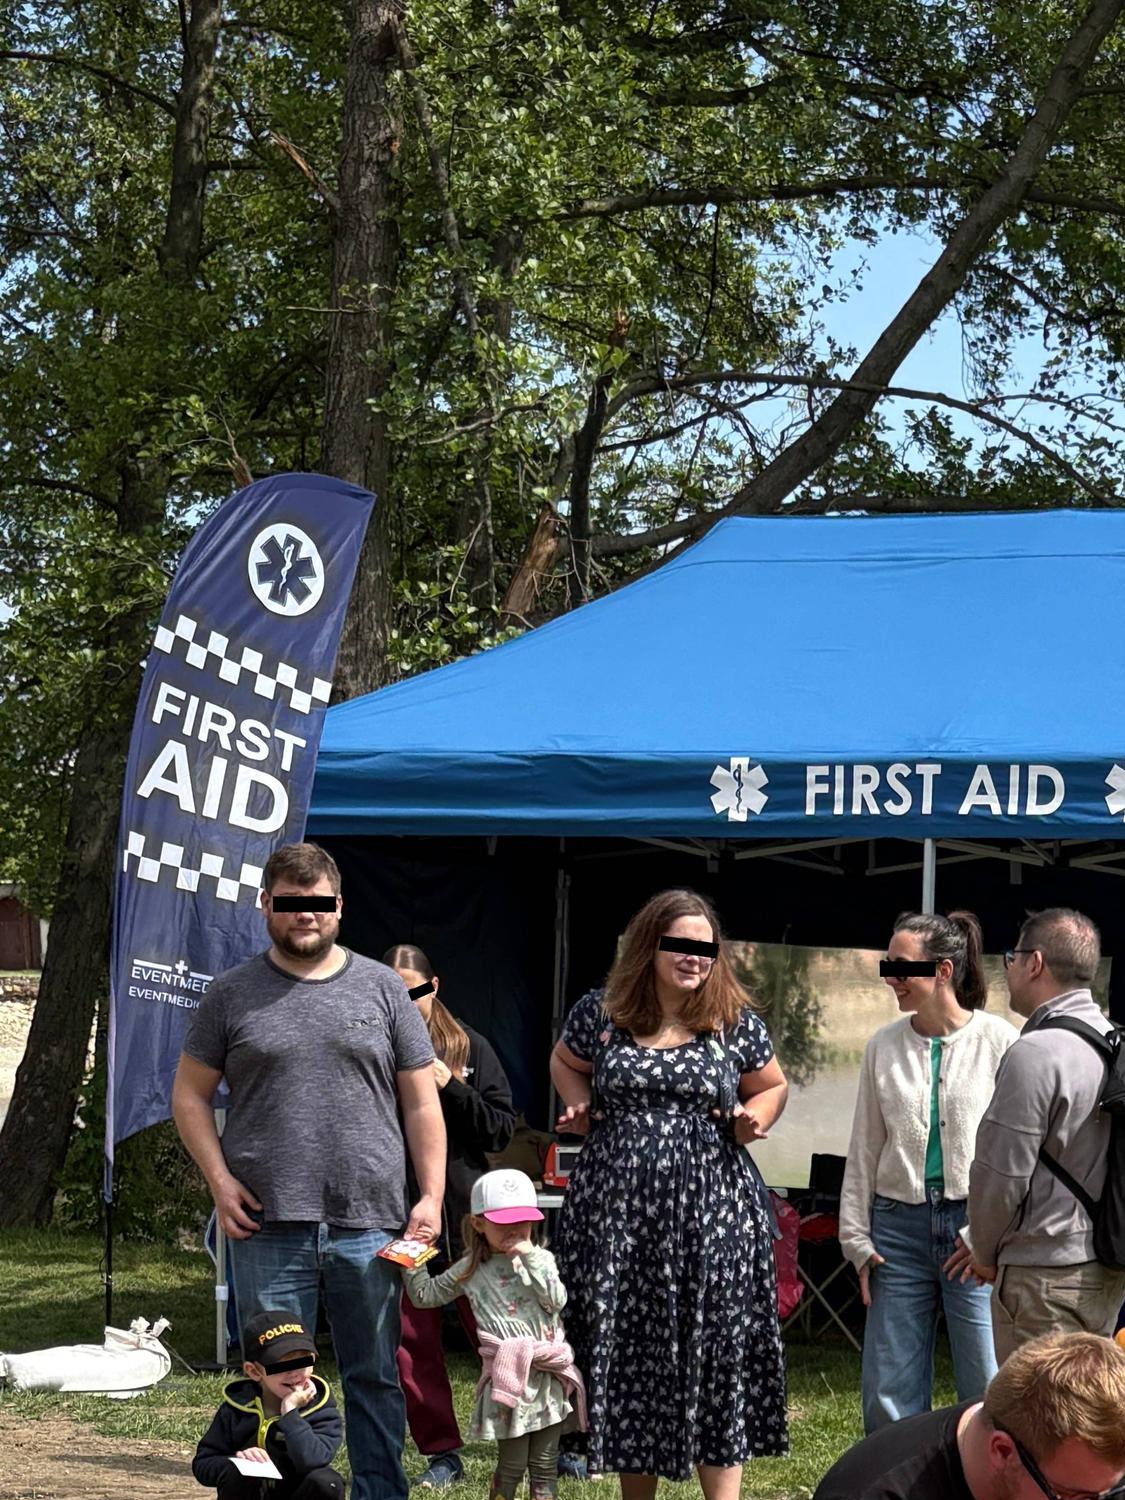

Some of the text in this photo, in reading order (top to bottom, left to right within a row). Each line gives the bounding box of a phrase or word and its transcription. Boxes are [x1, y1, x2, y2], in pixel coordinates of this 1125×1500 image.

[152, 681, 307, 772] FIRST
[137, 739, 289, 833] AID
[805, 763, 1065, 815] FIRST AID
